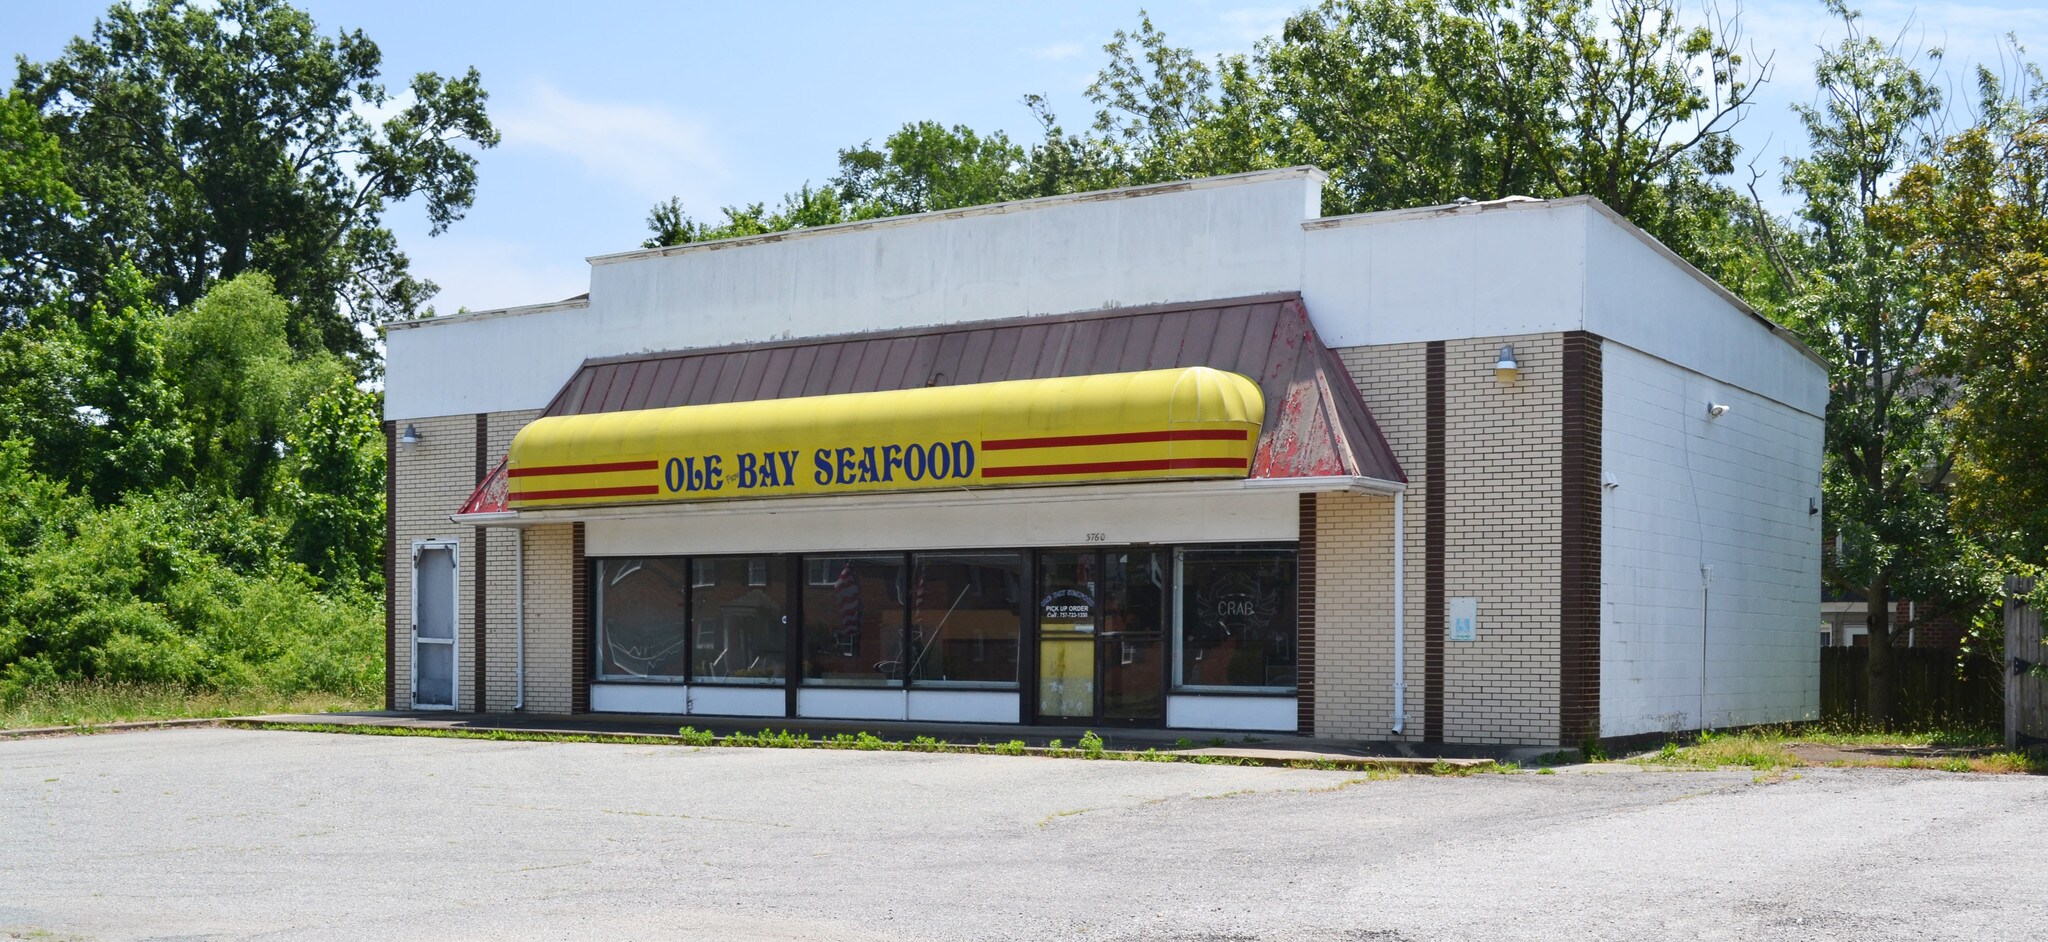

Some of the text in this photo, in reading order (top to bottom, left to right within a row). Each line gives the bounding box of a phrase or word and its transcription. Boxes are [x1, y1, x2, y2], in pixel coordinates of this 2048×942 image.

[665, 440, 975, 492] OLE BAY SEAFOOD
[1218, 601, 1254, 615] CRAB
